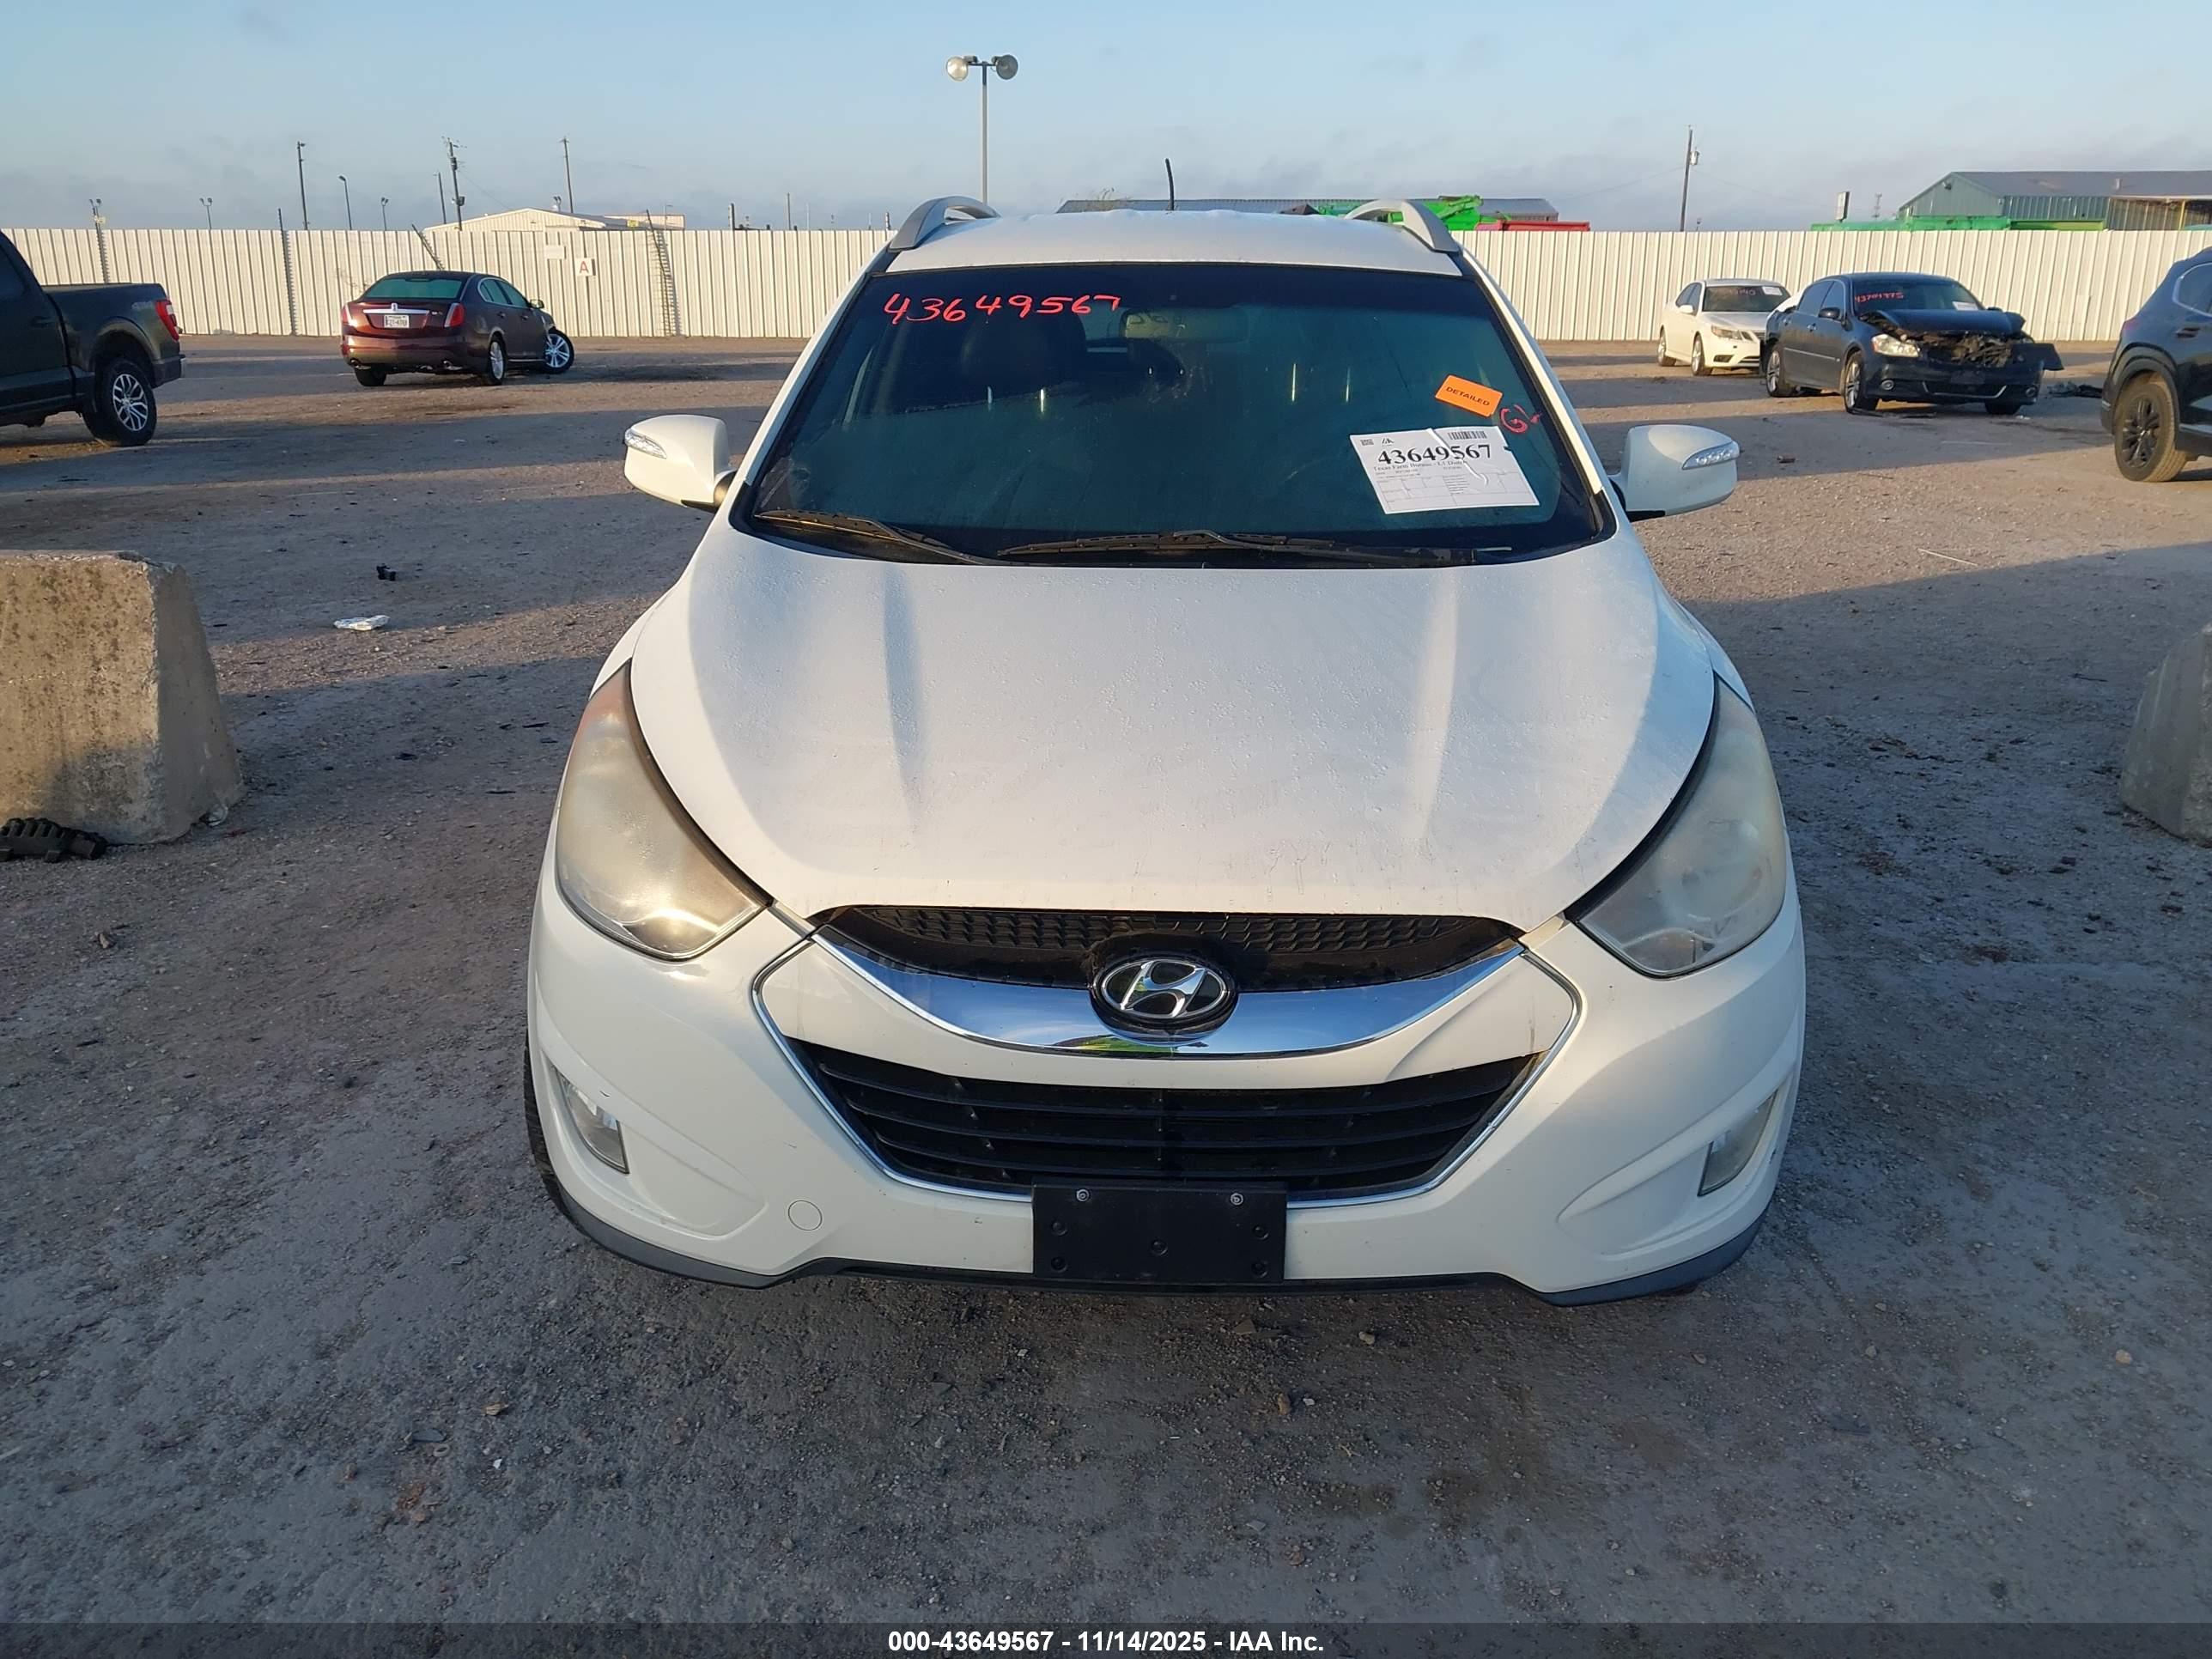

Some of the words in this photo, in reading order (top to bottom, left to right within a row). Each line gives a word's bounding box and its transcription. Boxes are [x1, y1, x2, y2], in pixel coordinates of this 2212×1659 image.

[580, 260, 589, 274] A
[883, 292, 1121, 325] 43649567
[1445, 386, 1491, 406] DETAILED
[1377, 444, 1492, 465] 43649567
